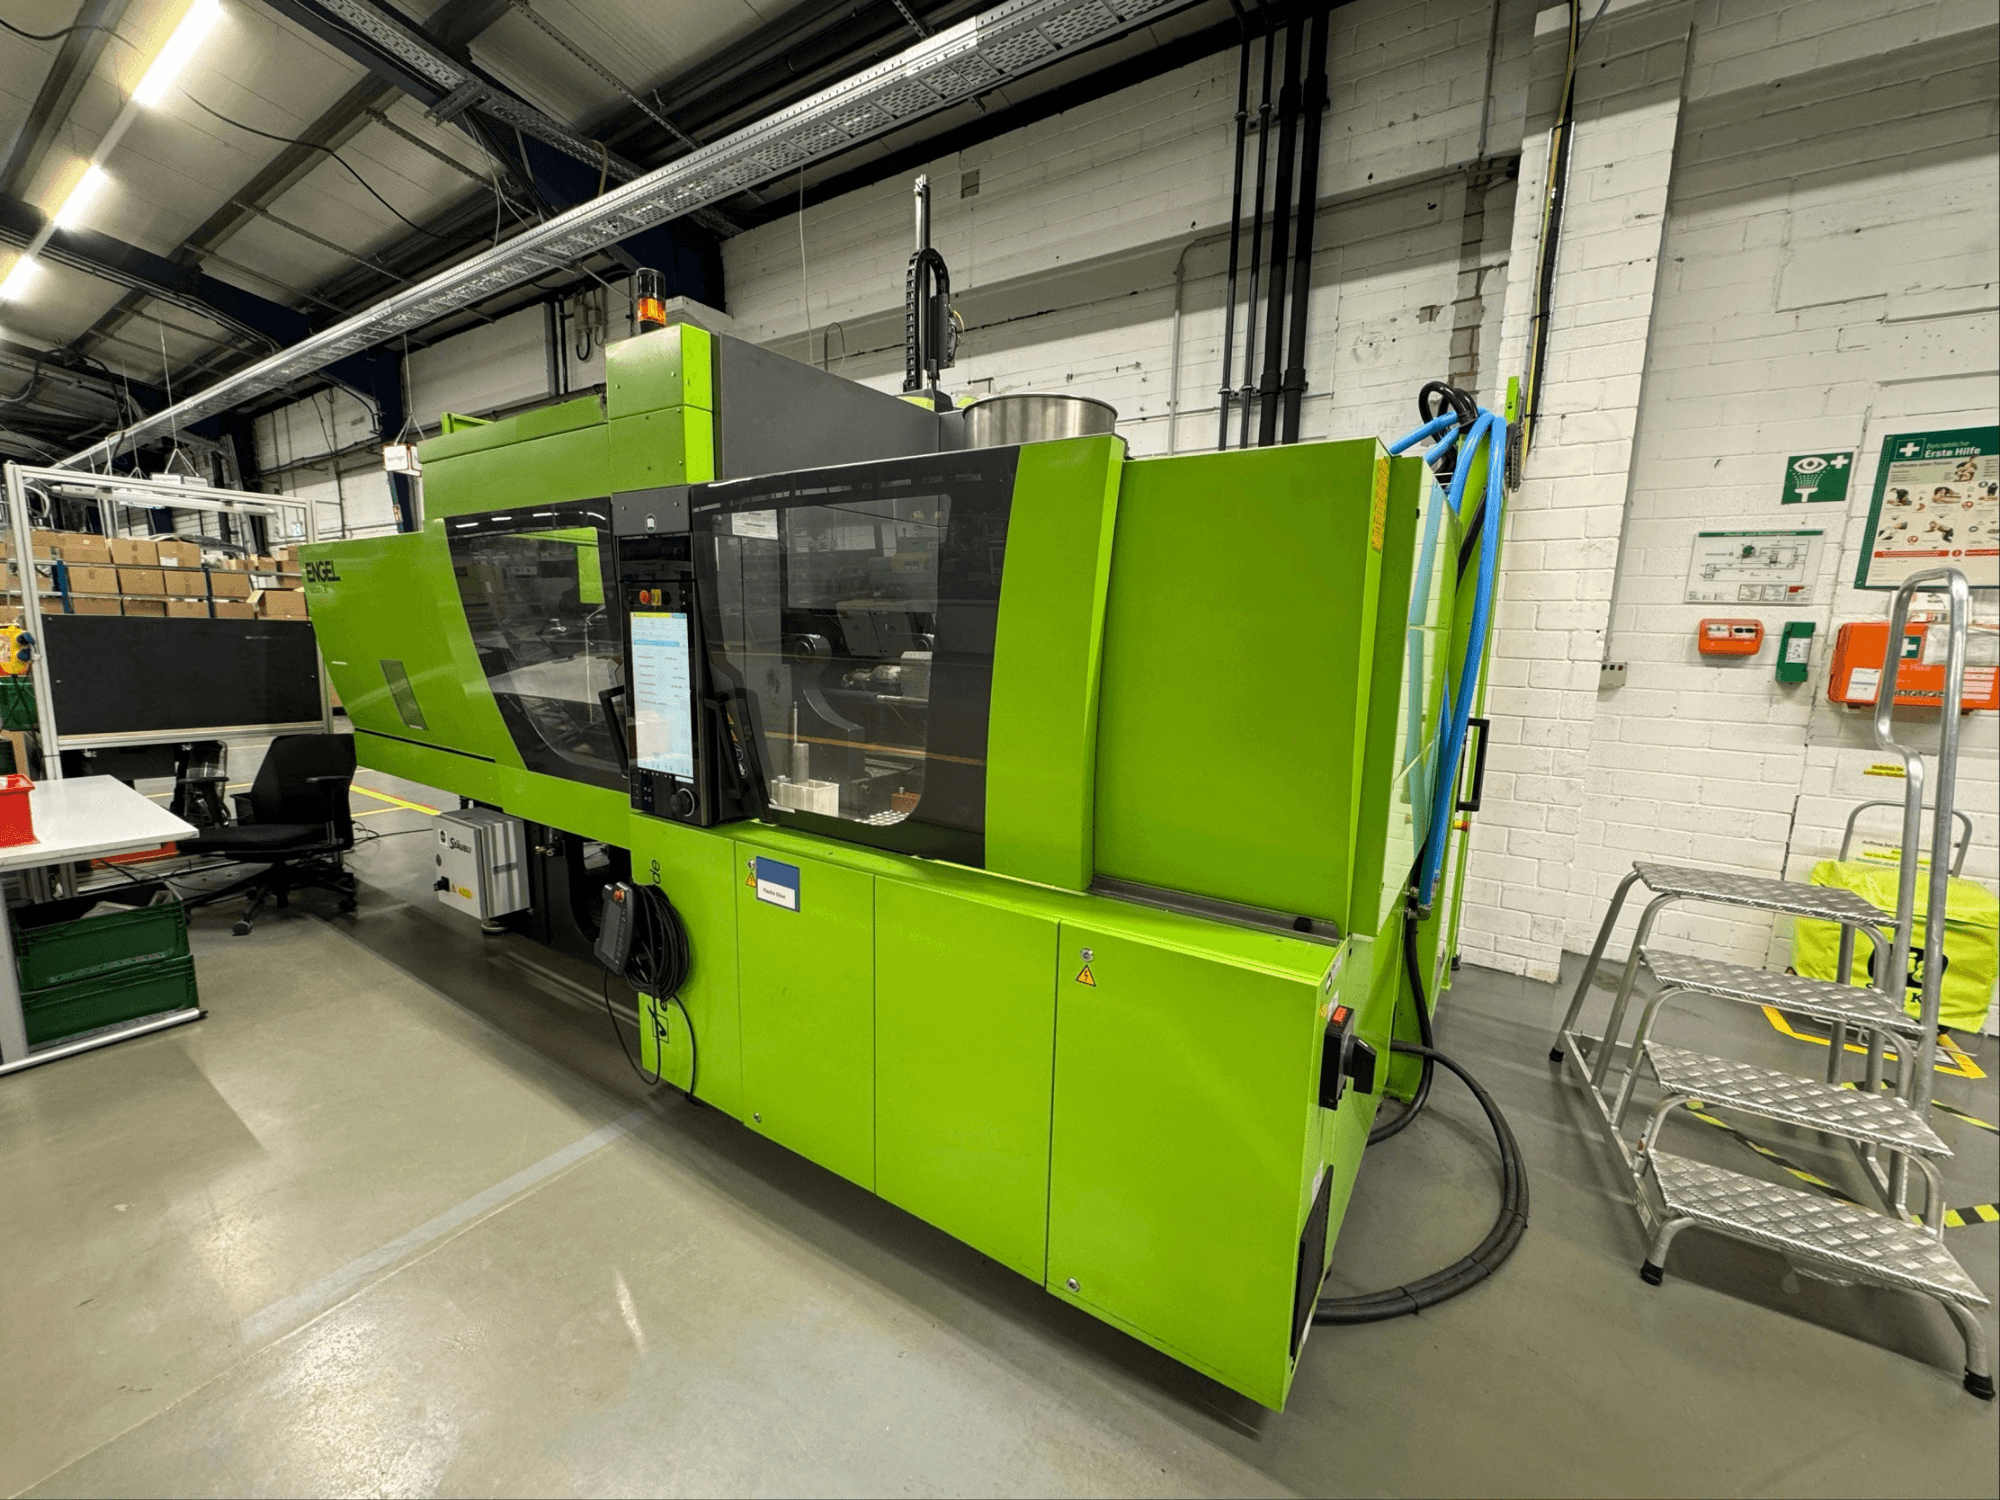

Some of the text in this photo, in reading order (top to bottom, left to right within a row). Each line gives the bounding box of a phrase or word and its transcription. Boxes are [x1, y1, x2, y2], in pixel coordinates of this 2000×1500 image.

[1925, 446, 1981, 458] Erste Hilfe
[305, 560, 341, 582] ENGEL
